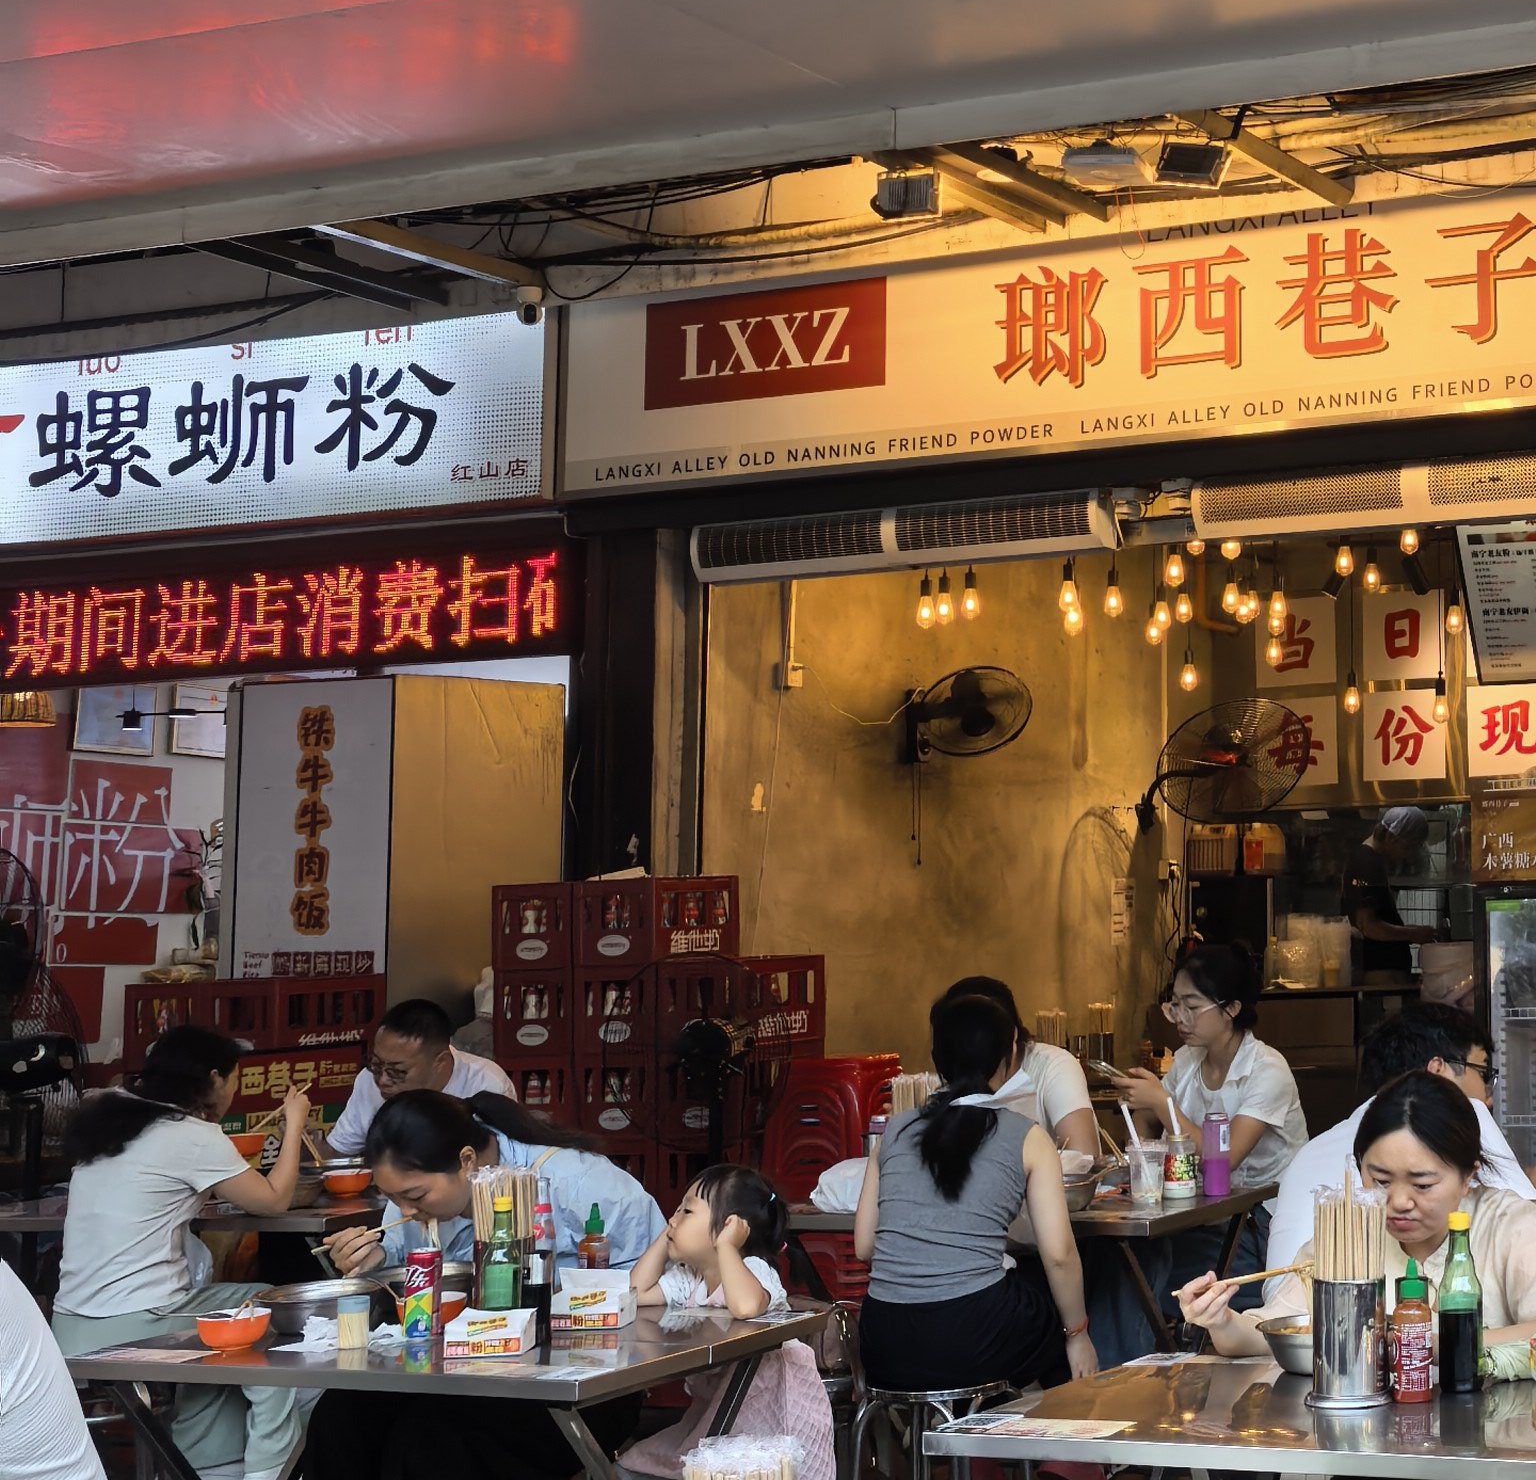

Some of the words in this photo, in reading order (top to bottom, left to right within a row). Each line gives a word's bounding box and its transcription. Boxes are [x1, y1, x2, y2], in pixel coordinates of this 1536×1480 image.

[680, 306, 850, 381] LXXZ
[28, 363, 457, 498] 螺蛳粉
[450, 458, 529, 484] 红山店
[595, 462, 662, 482] LANGXI
[672, 454, 728, 475] ALLEY
[739, 449, 775, 468] OLD
[787, 440, 877, 462] NANNING
[888, 432, 958, 453] FRIEND
[970, 422, 1054, 444] POWDER
[1080, 413, 1155, 435] LANGXI
[1168, 405, 1230, 426] ALLEY
[1243, 399, 1284, 418] OLD
[1298, 387, 1398, 409] NANNING
[1412, 377, 1490, 399] FRIEND
[295, 708, 333, 933] 铁牛牛肉饭
